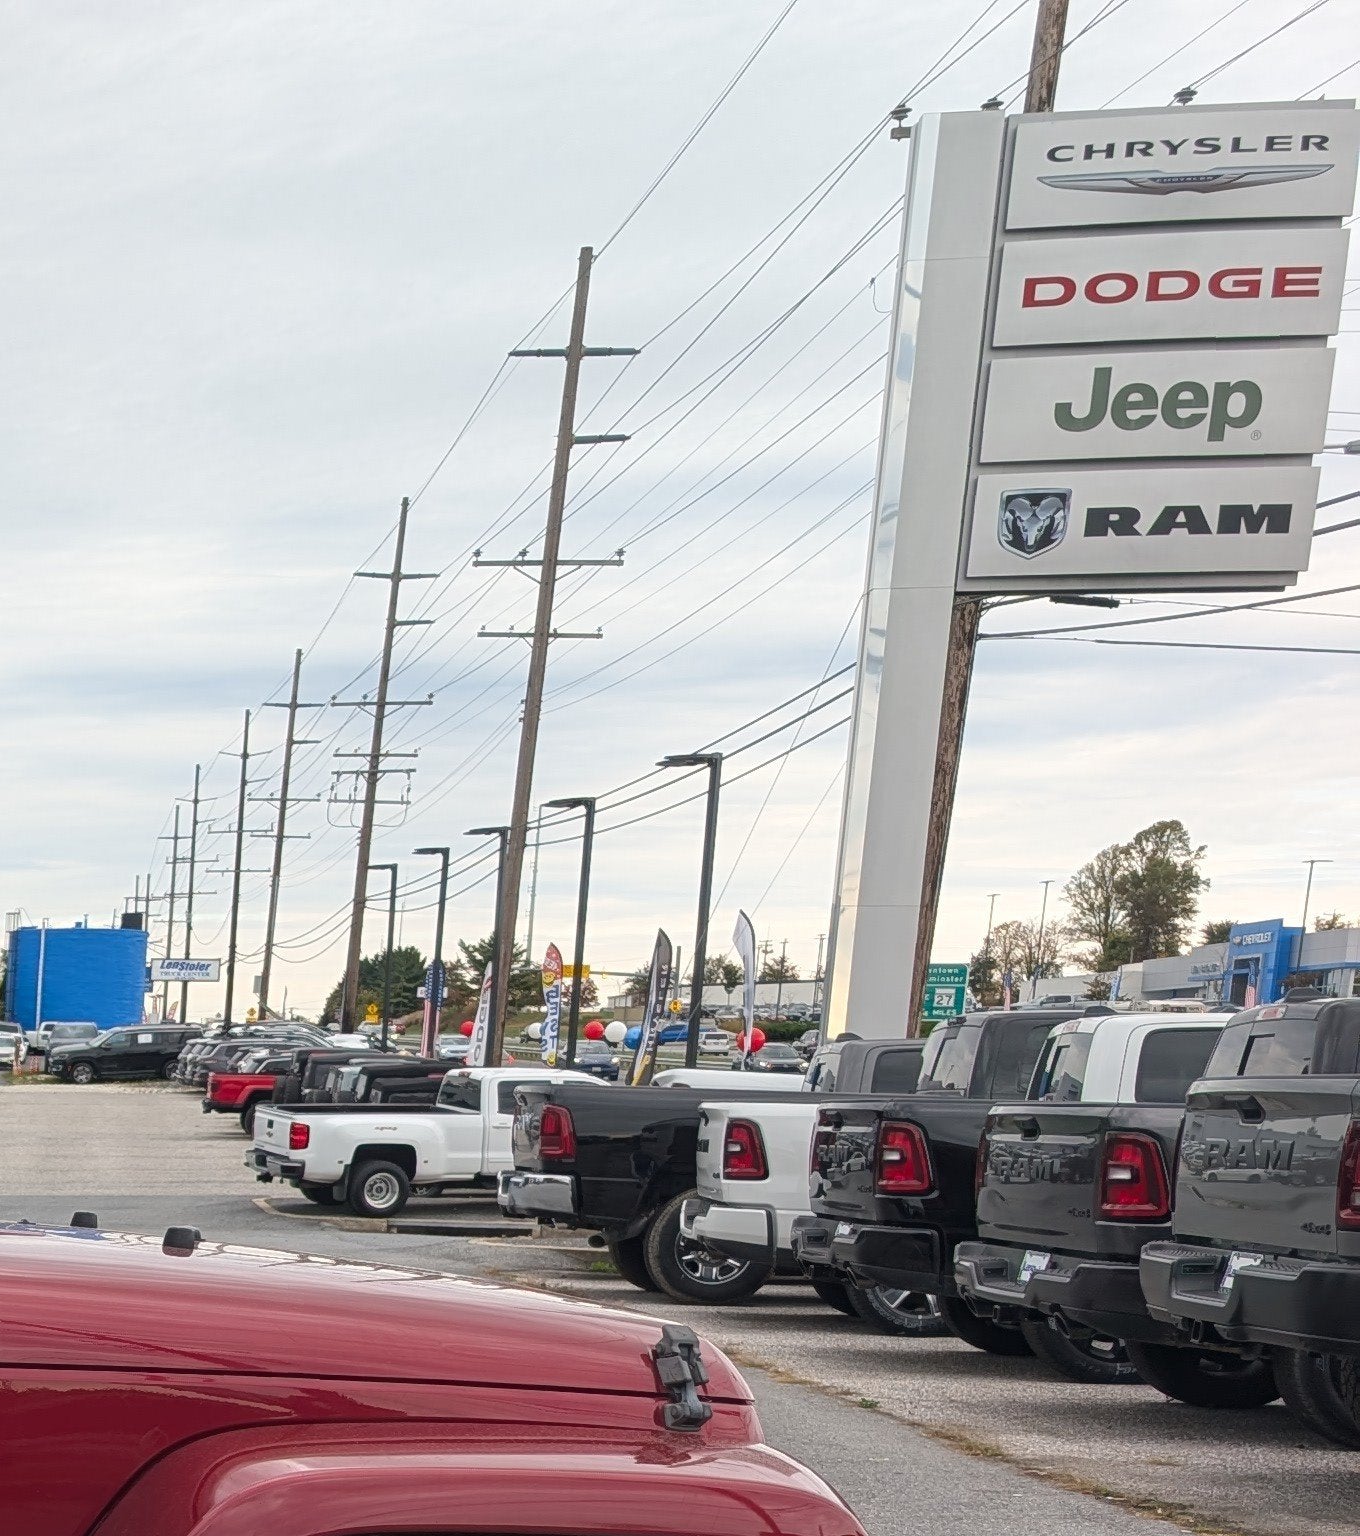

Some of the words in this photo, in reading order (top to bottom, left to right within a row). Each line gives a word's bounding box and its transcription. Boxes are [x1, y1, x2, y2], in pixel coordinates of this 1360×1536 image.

[1046, 134, 1330, 163] CHRYSLER
[1021, 266, 1323, 308] DODGE
[1054, 367, 1263, 442] Jeep
[1084, 503, 1292, 538] RAM
[1242, 931, 1273, 946] CHEVROLET
[936, 994, 953, 1006] 27
[996, 1156, 1060, 1181] RAM
[1206, 1138, 1295, 1170] RAM
